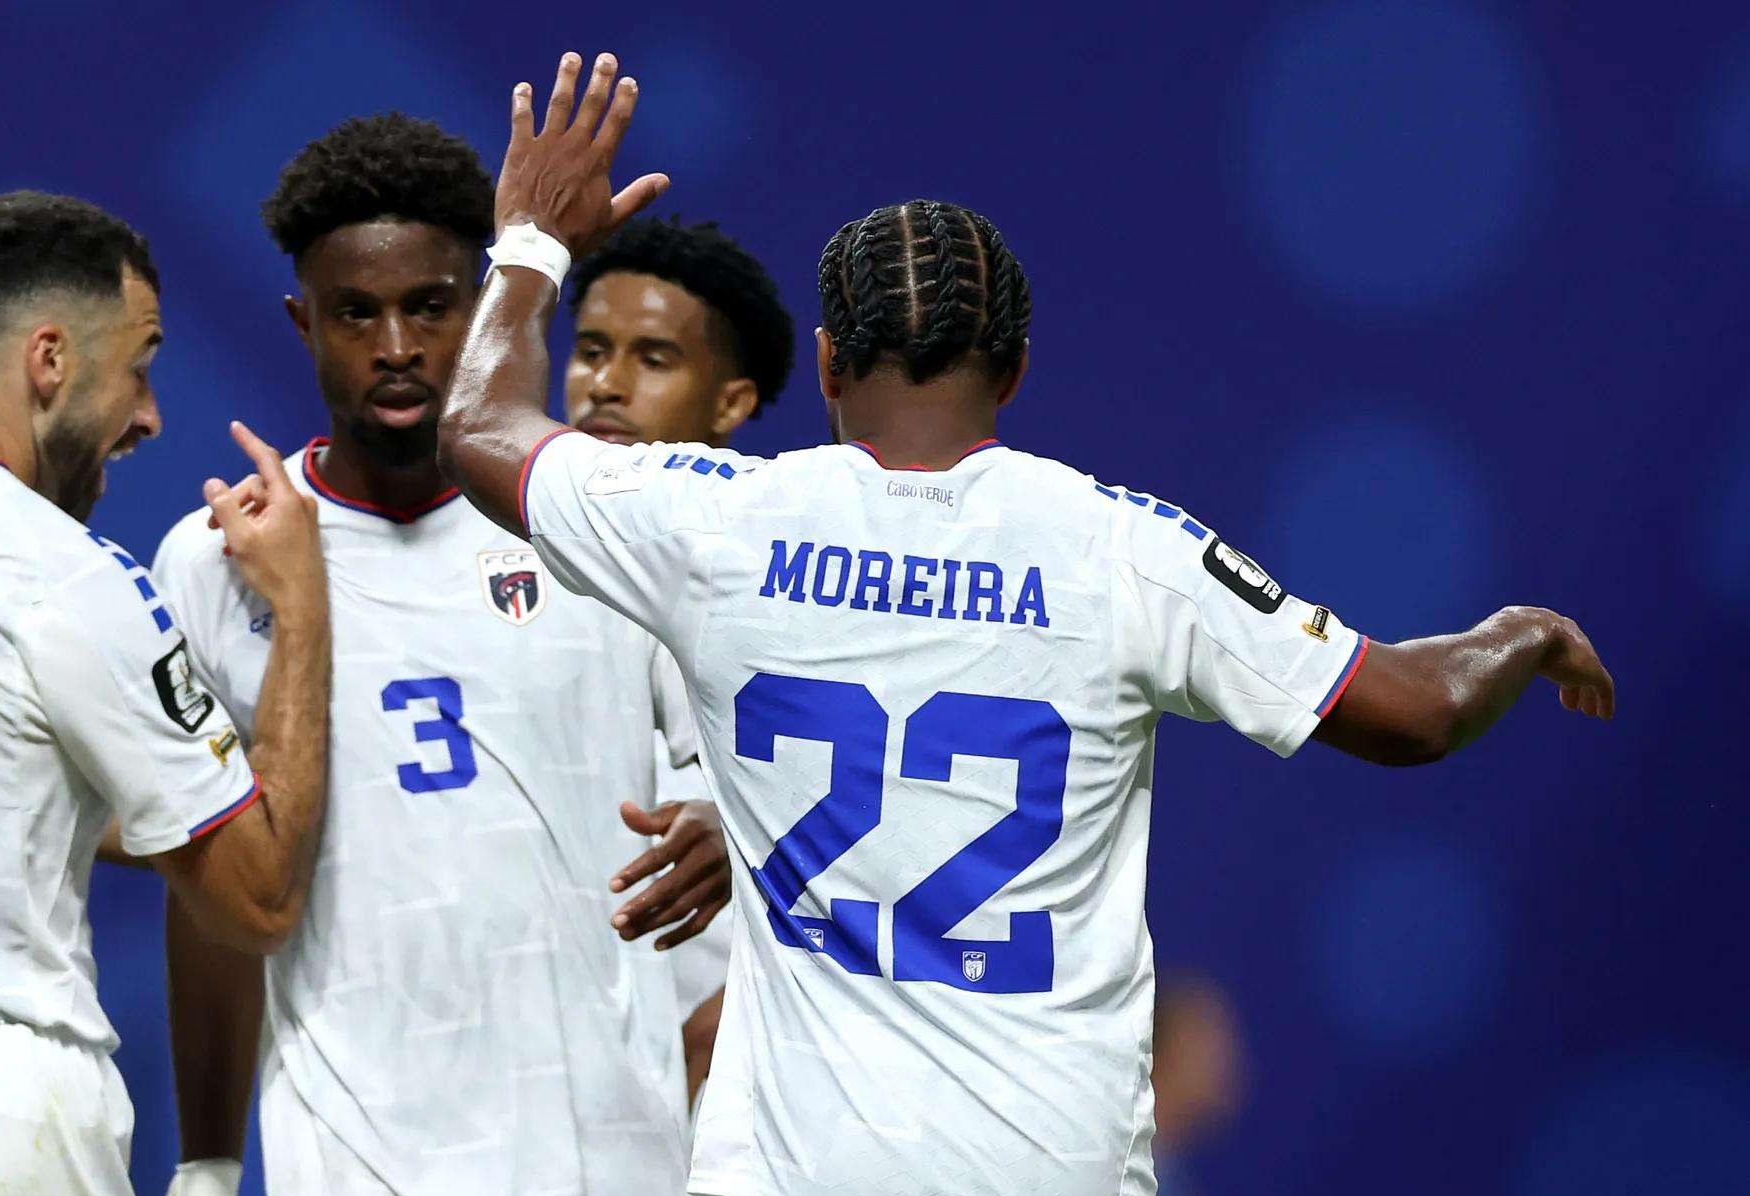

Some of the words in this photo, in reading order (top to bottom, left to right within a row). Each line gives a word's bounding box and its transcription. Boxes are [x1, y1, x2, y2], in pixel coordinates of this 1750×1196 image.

[759, 539, 1050, 628] MOREIRA
[381, 677, 478, 794] 3
[735, 672, 1072, 993] 22
